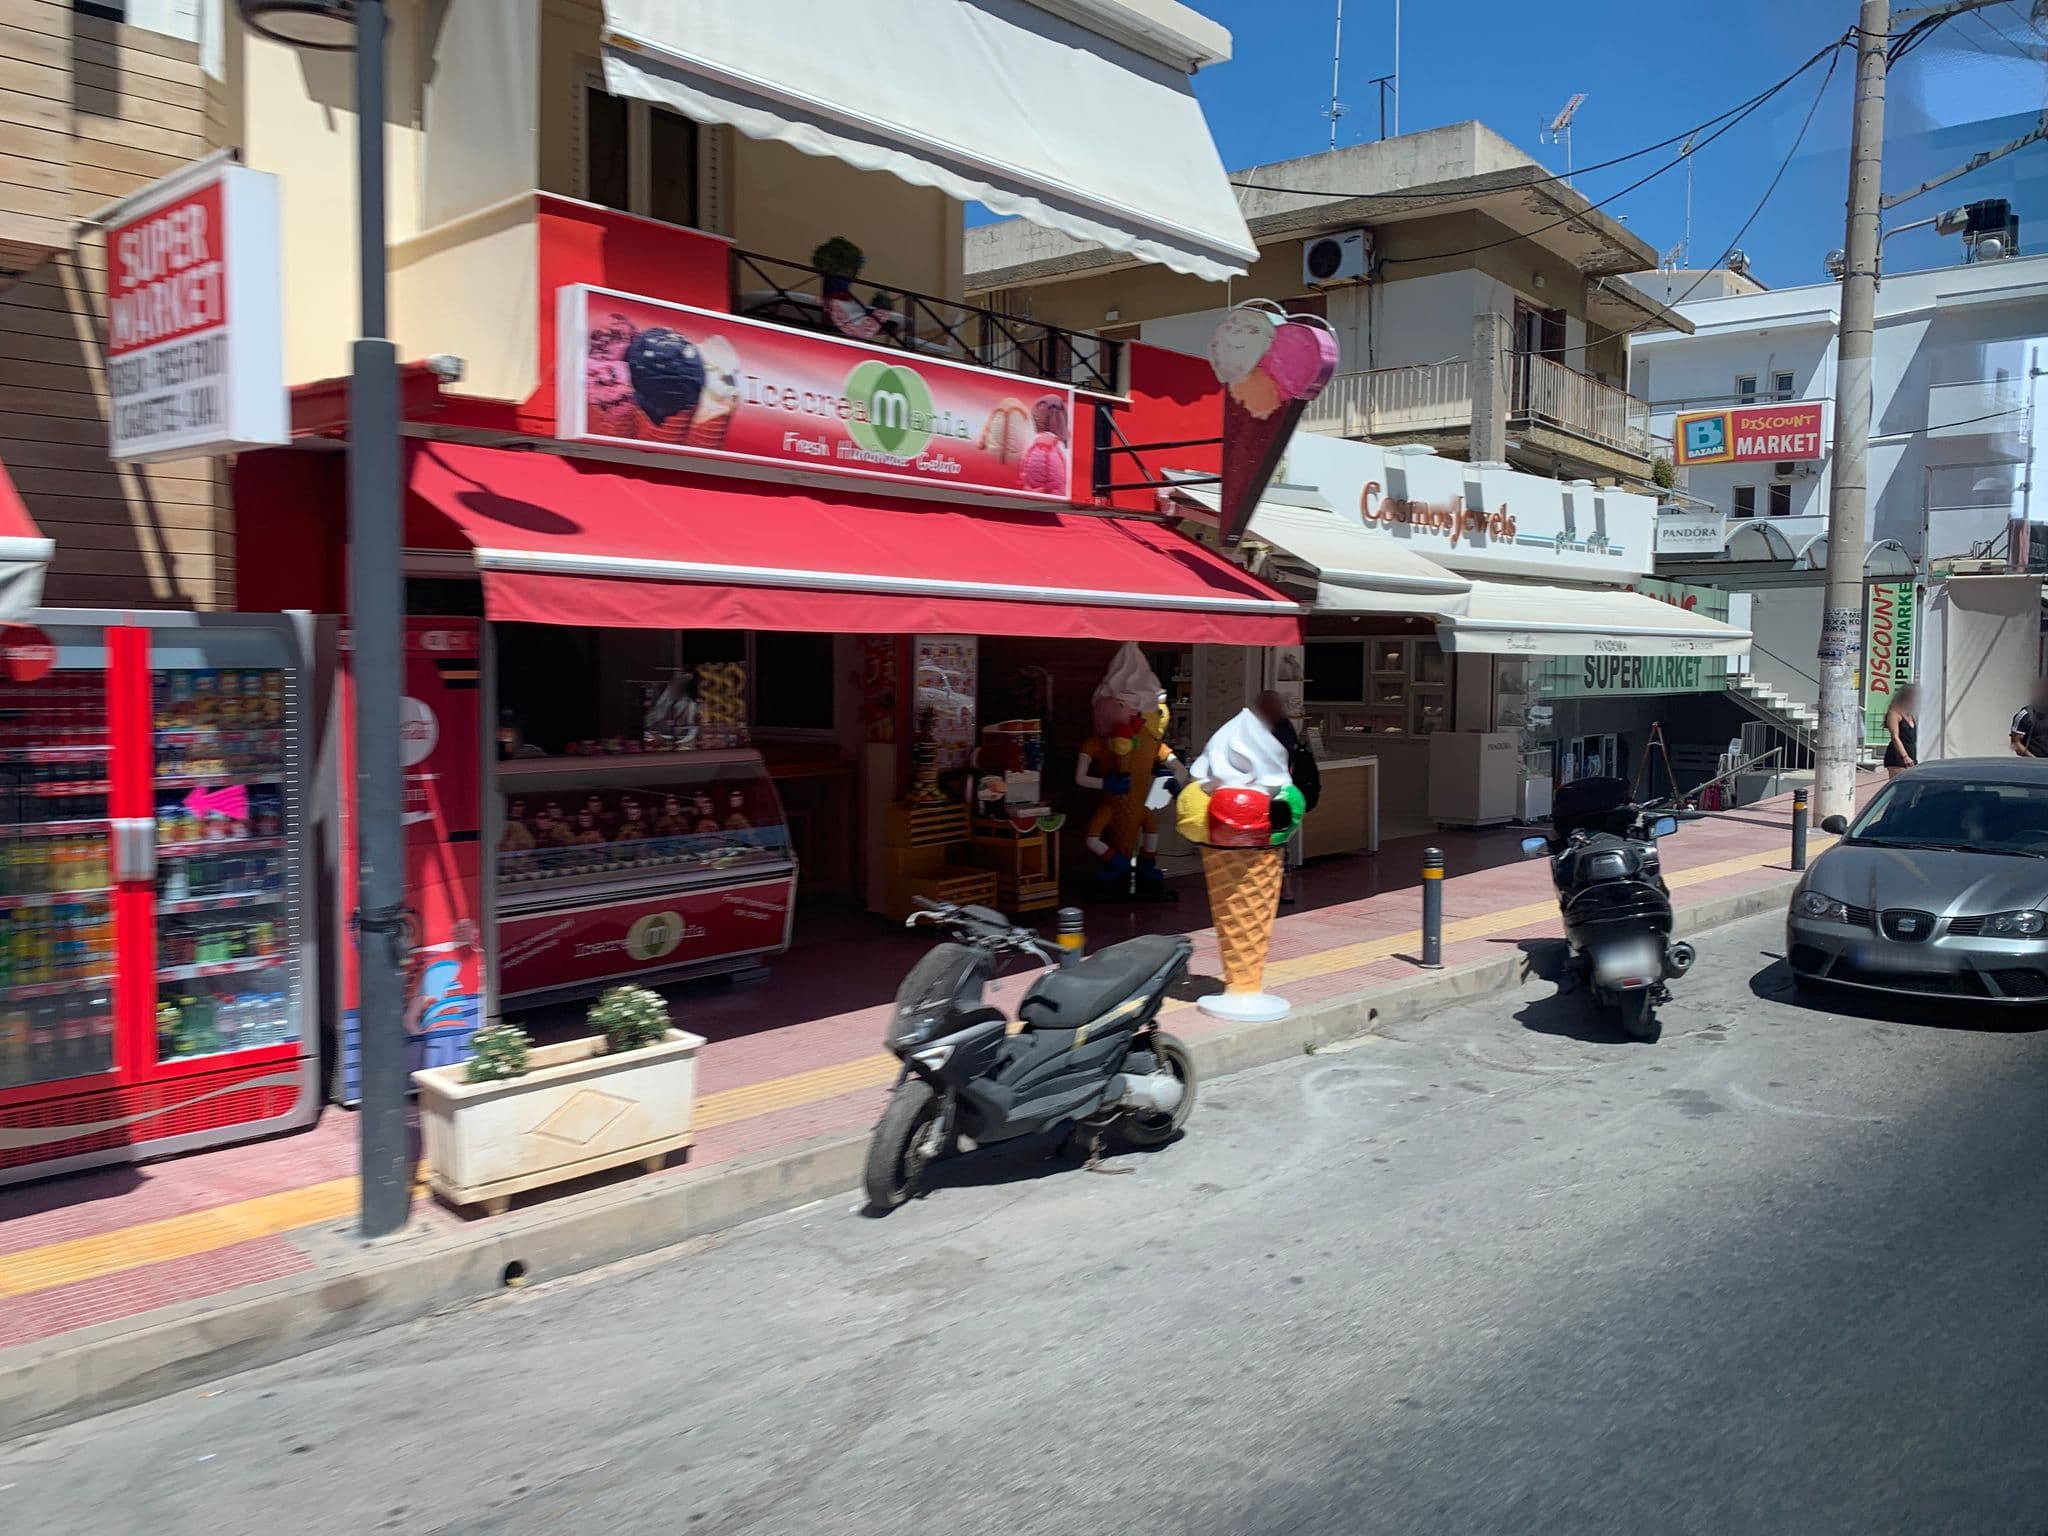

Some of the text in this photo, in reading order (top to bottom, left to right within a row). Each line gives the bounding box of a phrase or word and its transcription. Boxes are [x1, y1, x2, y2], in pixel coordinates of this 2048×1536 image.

[118, 204, 209, 288] SUPER
[110, 261, 225, 350] MARKET
[1740, 414, 1816, 431] DISCOUNT
[1687, 445, 1724, 459] BAZAAR
[1736, 432, 1818, 456] MARKET
[1662, 527, 1717, 538] PANDORA
[1869, 583, 1894, 695] DISCOUNT
[1894, 582, 1914, 692] UPERMARKE
[1583, 655, 1702, 689] SUPERMARKET
